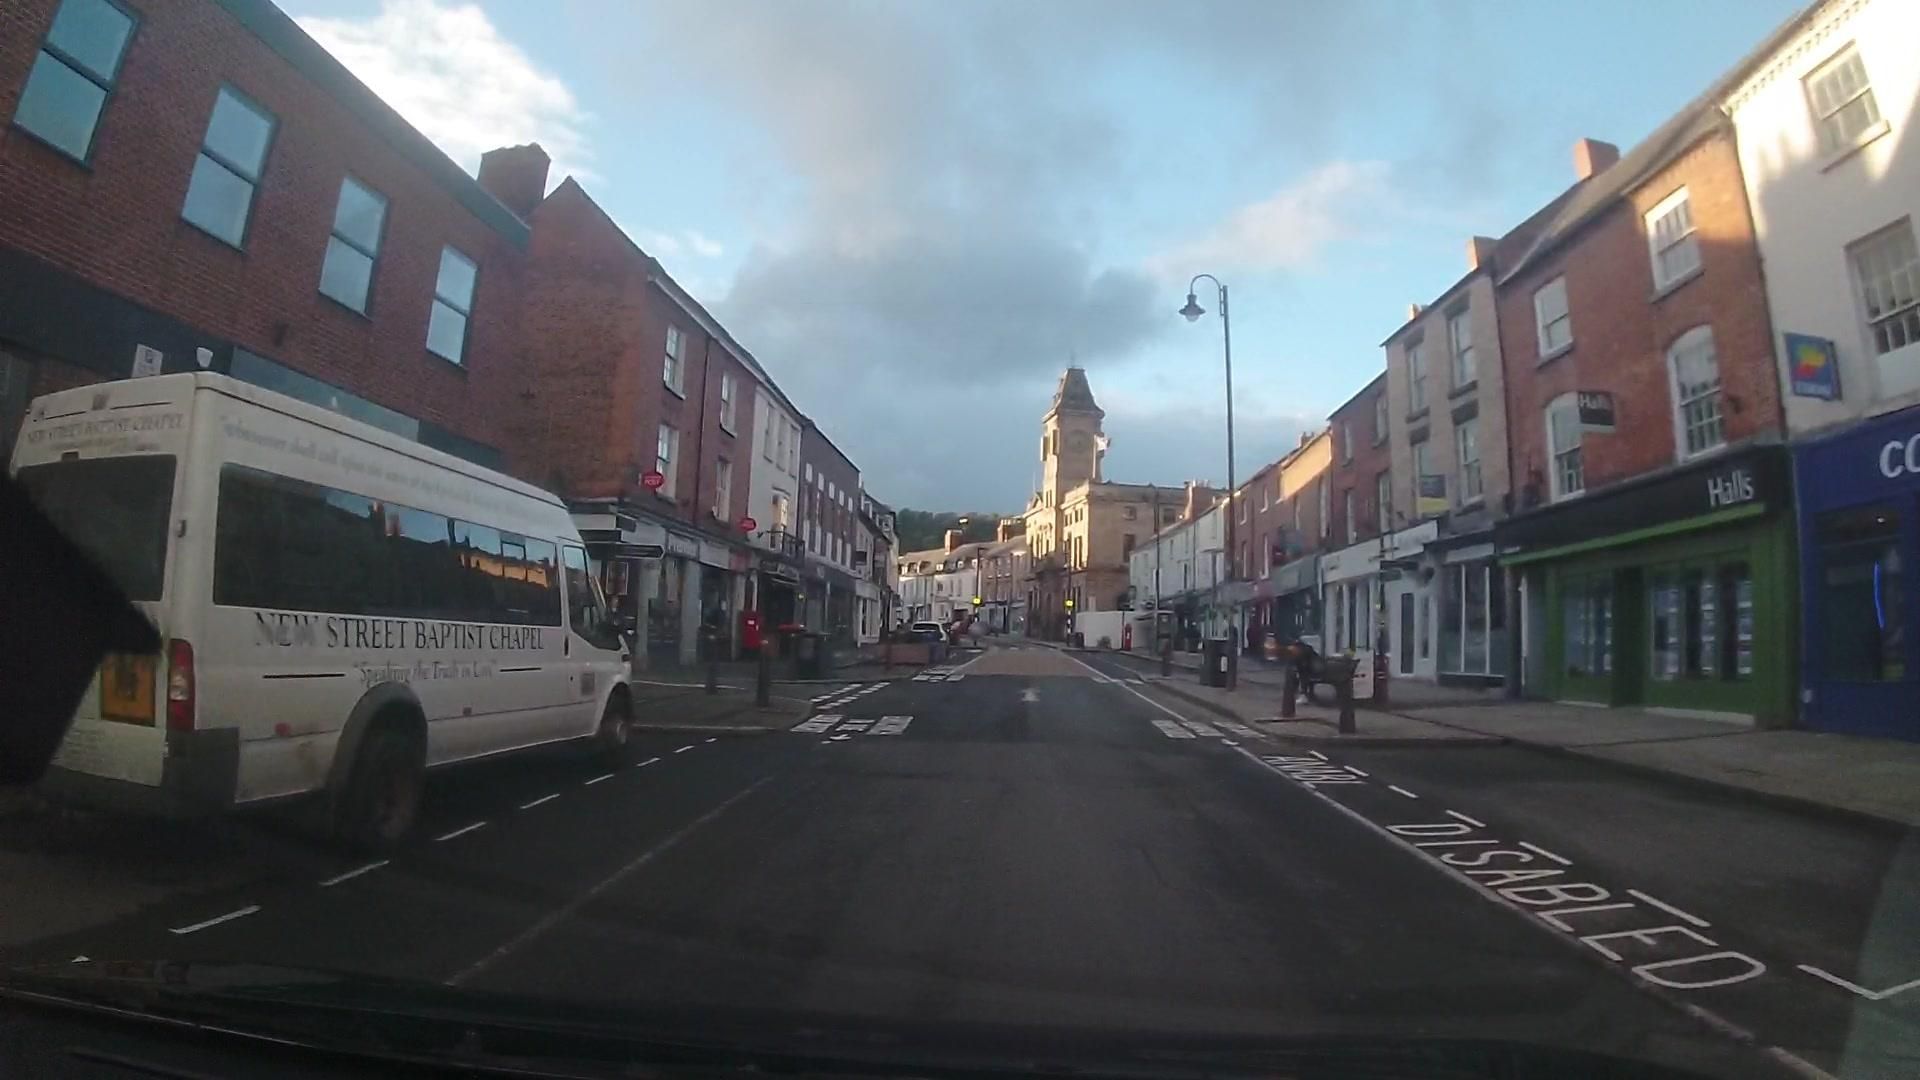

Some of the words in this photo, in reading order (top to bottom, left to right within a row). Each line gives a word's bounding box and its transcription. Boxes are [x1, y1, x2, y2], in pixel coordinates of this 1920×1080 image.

[1706, 469, 1755, 508] Halls
[255, 611, 319, 647] NEW
[327, 616, 409, 649] STREET
[415, 621, 485, 650] BAPTIST
[489, 625, 545, 650] CHAPEL
[1385, 822, 1767, 990] DISABLED
